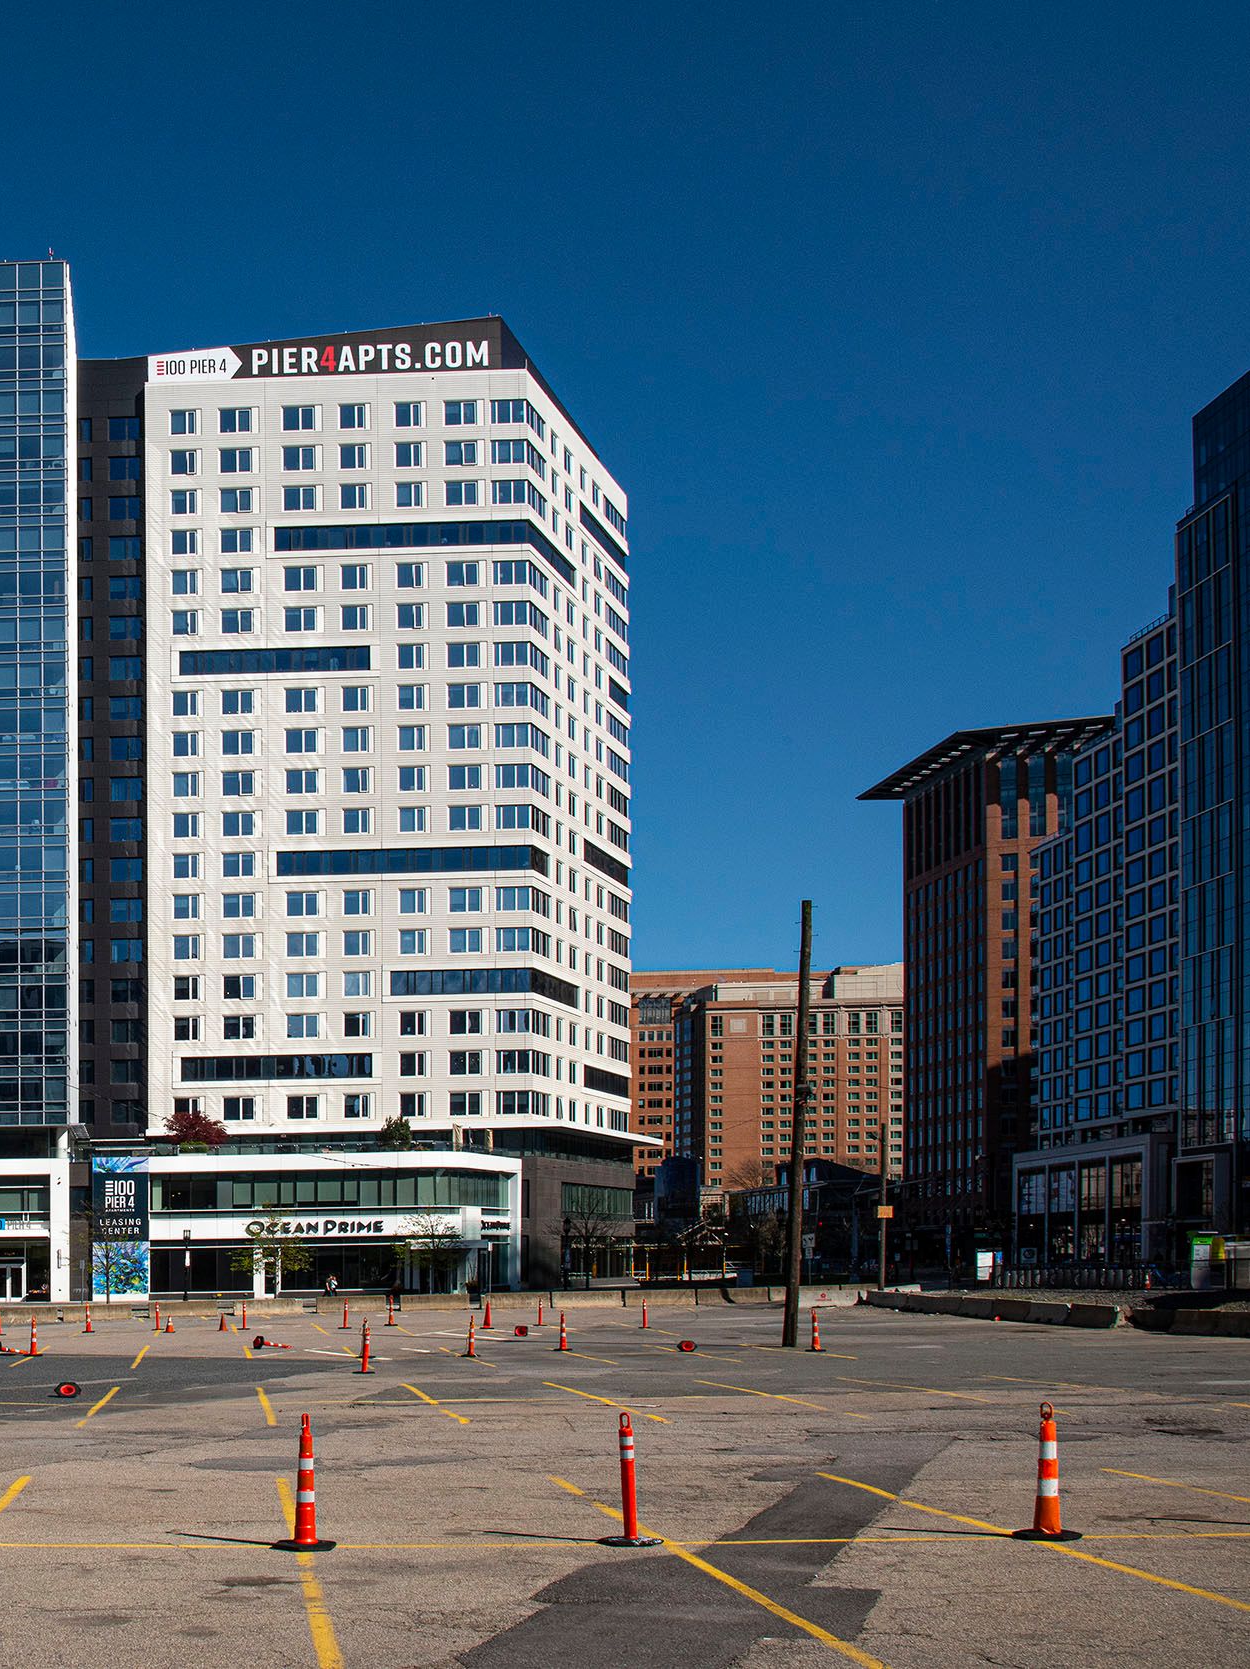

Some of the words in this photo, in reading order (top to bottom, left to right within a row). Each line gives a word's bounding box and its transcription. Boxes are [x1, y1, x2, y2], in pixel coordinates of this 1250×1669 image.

[251, 340, 490, 376] PIER4APTS.COM
[165, 360, 185, 375] 100
[190, 359, 216, 375] PIER
[219, 358, 226, 373] 4
[114, 1180, 135, 1195] 100
[105, 1196, 126, 1208] PIER
[128, 1196, 135, 1208] 4
[7, 1219, 25, 1230] PIER
[99, 1218, 142, 1226] LEASING
[245, 1220, 319, 1237] OCEAN
[323, 1219, 384, 1236] PRIME
[101, 1227, 140, 1235] CENTER
